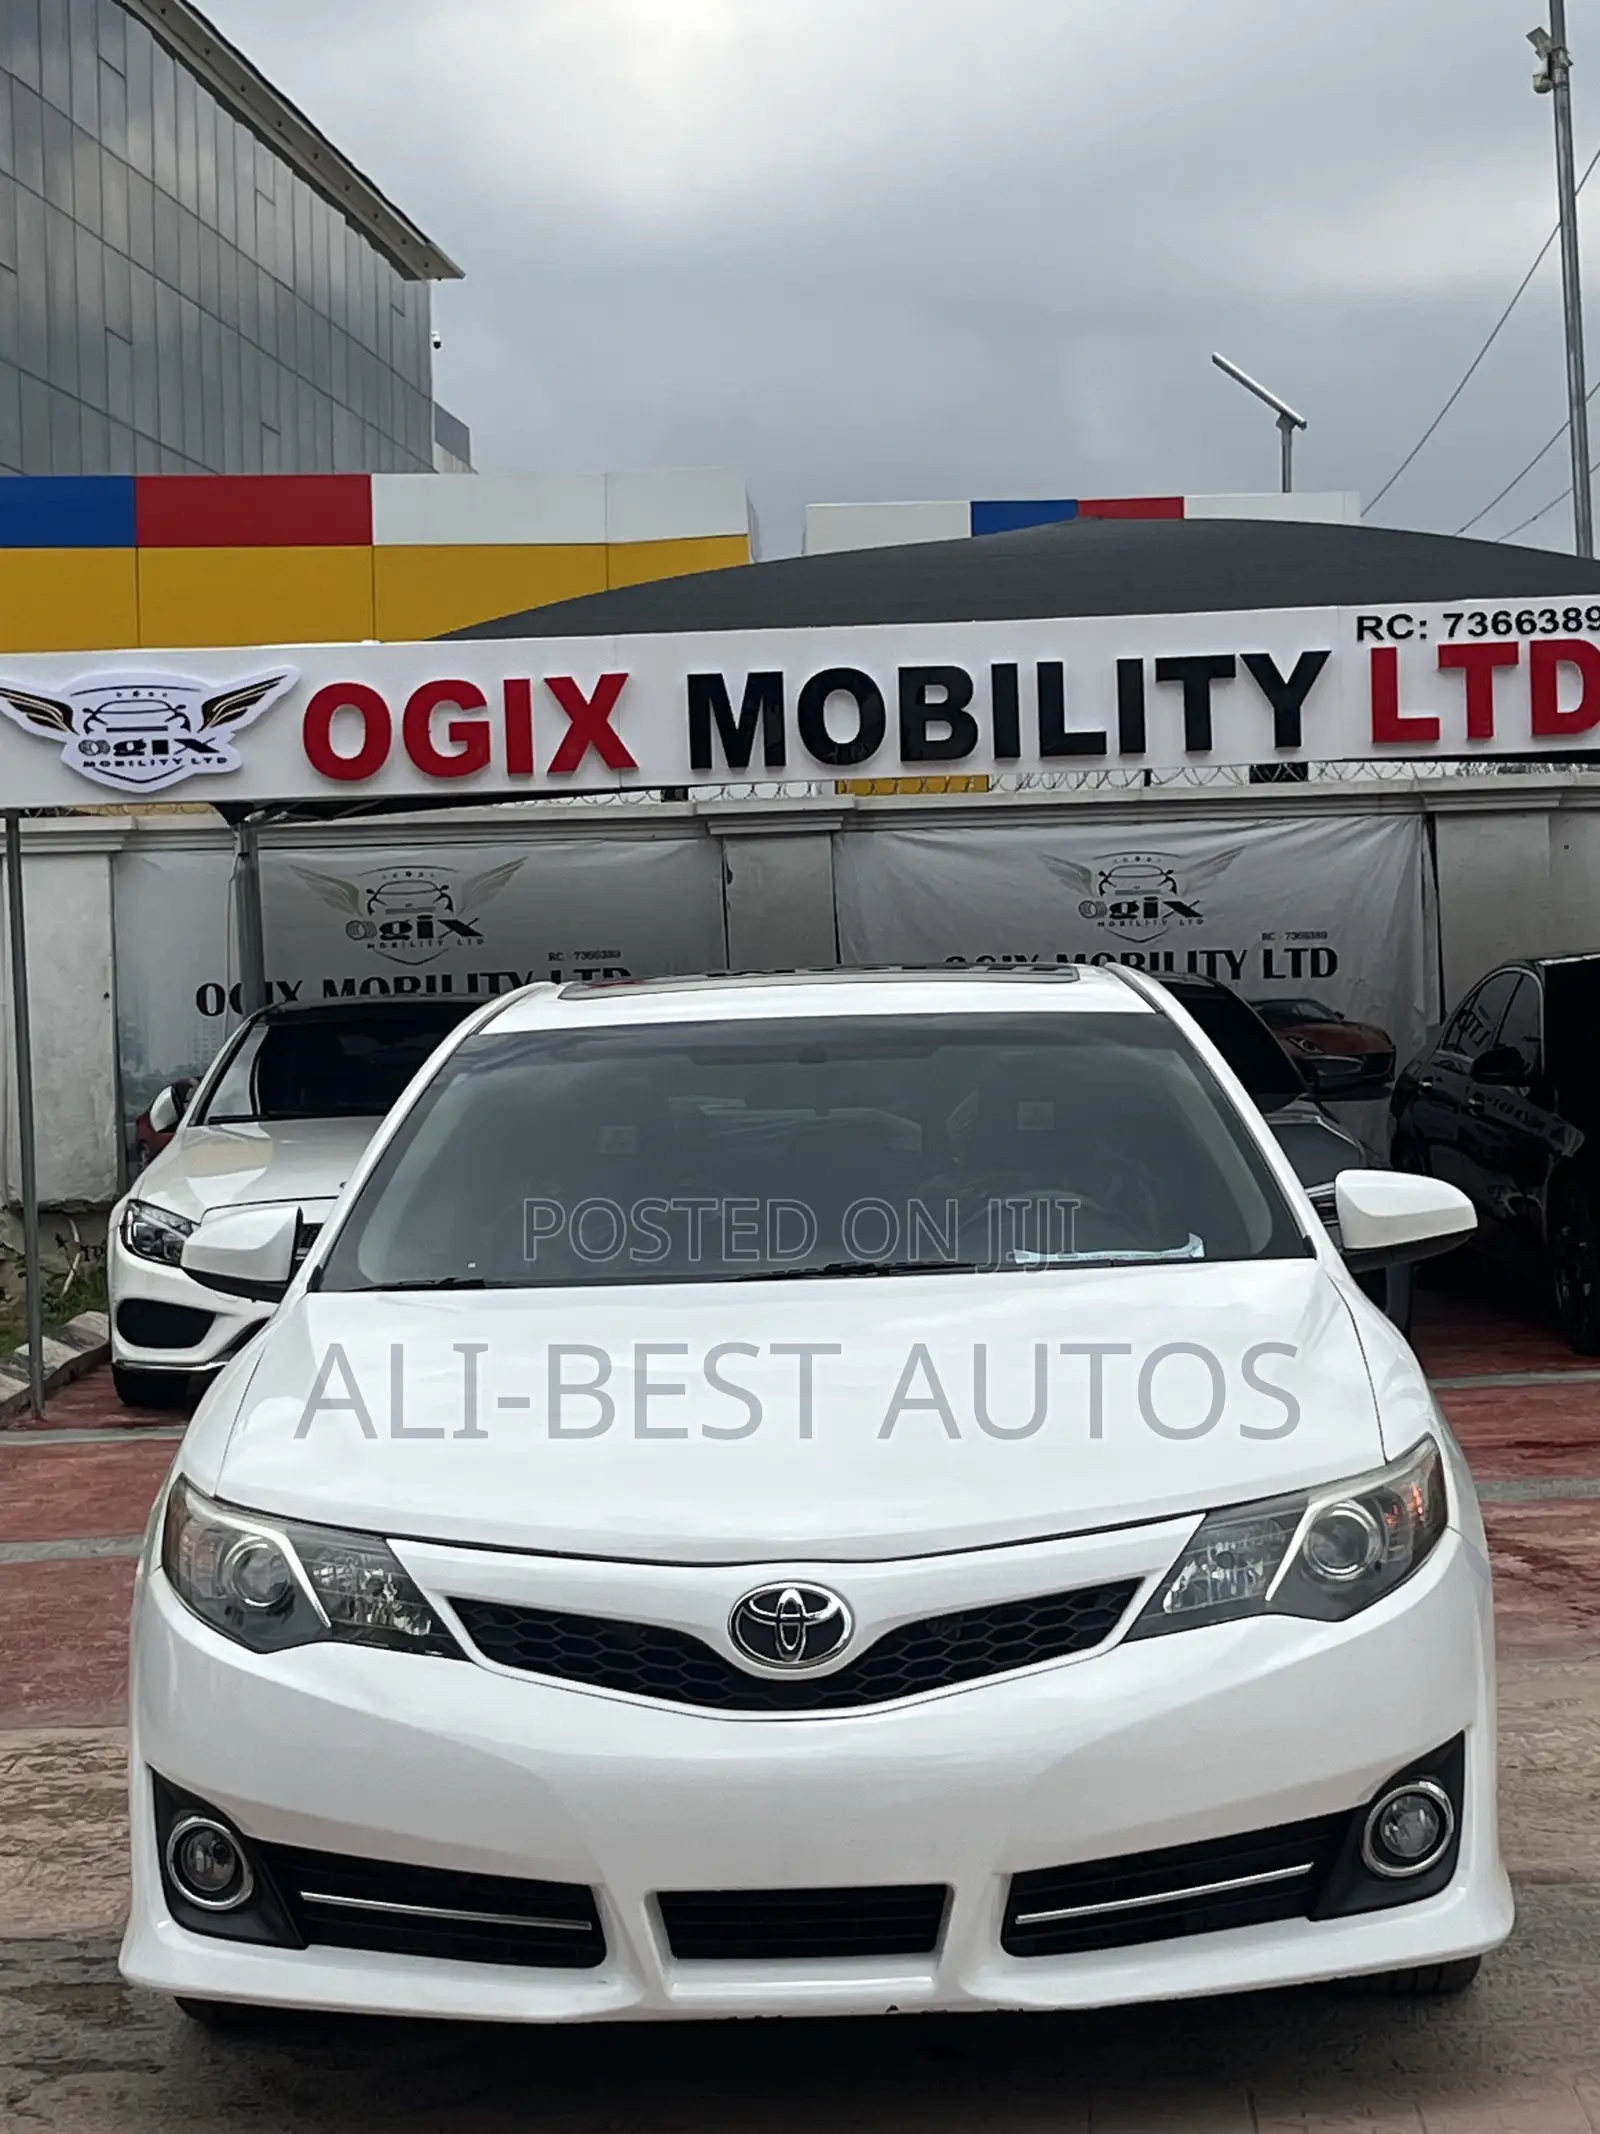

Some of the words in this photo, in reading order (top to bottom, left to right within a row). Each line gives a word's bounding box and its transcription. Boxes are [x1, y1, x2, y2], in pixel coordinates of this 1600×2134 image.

[1357, 614, 1427, 641] RC:
[1442, 606, 1600, 638] 7366389
[303, 672, 638, 781] OGIX
[687, 650, 1332, 770] MOBILITY
[1371, 639, 1600, 744] LTD
[1262, 947, 1338, 980] LTD
